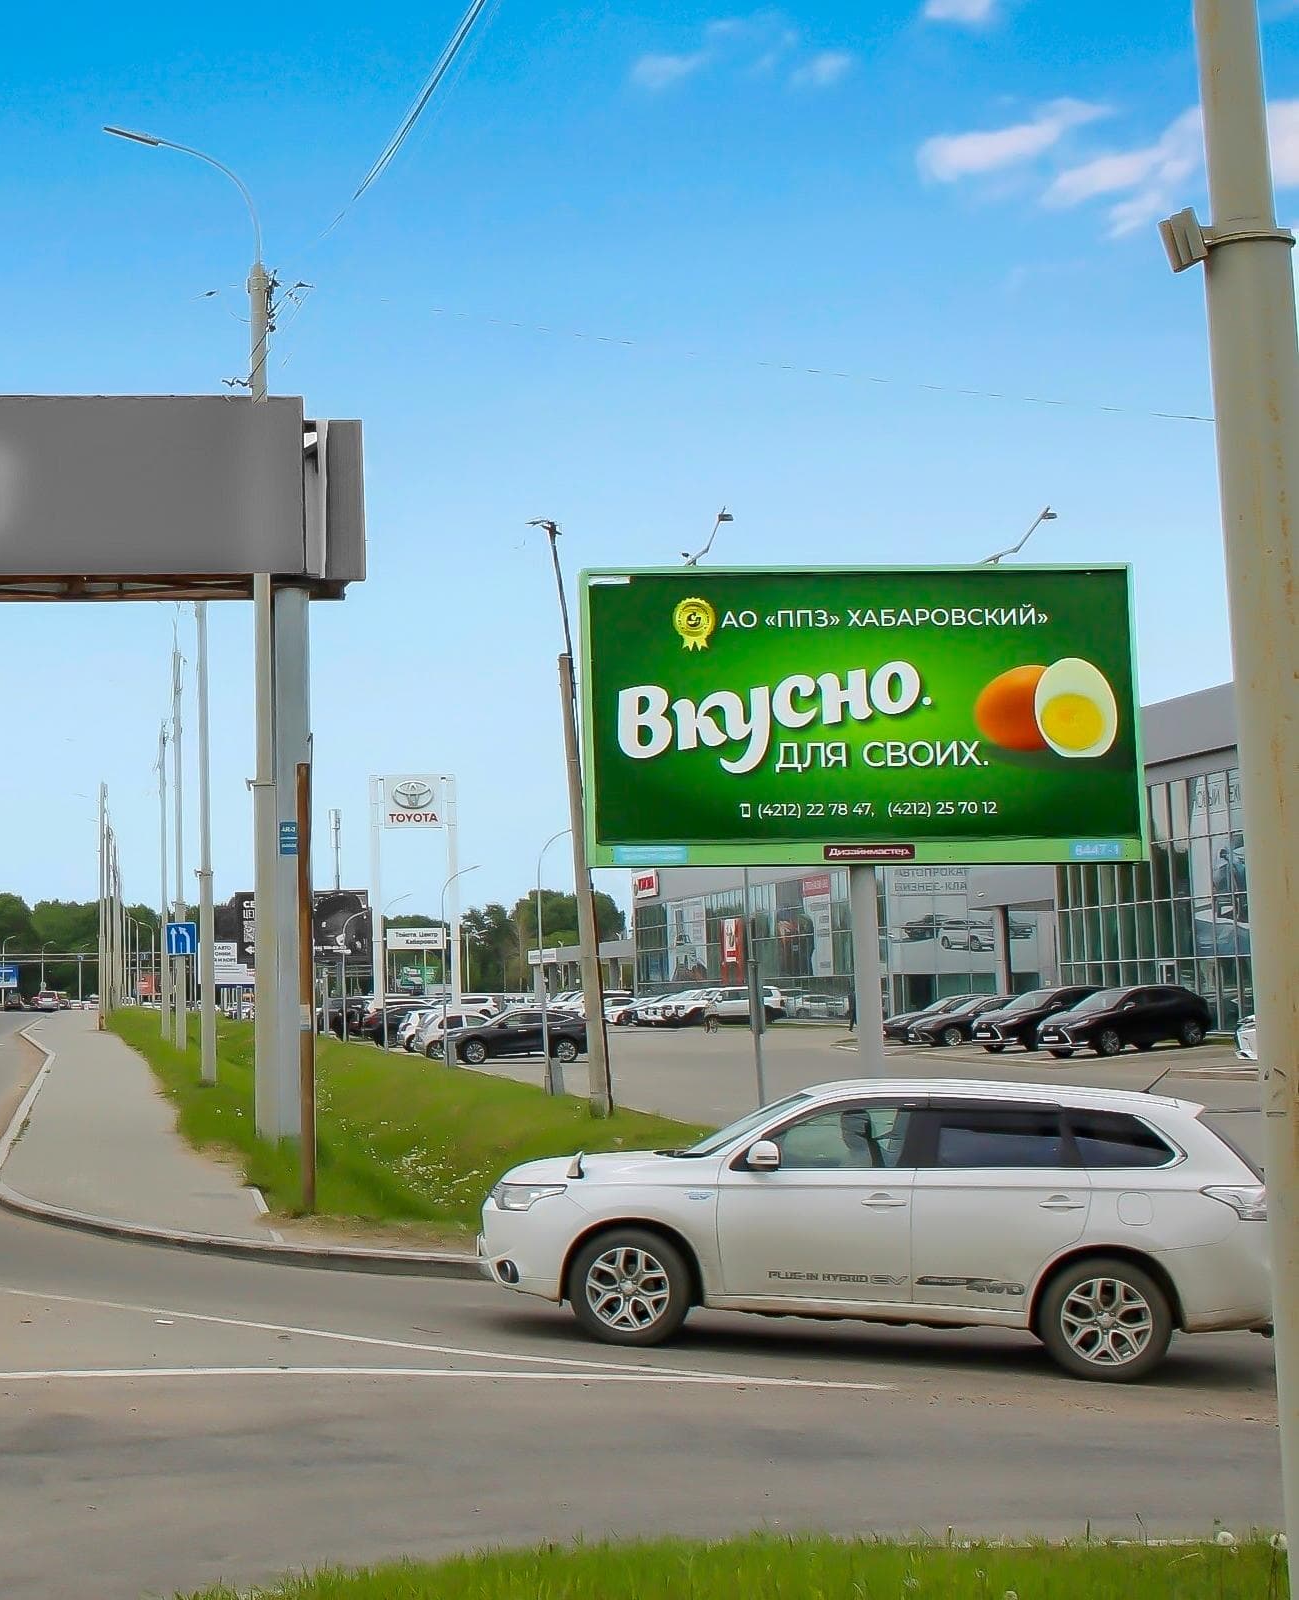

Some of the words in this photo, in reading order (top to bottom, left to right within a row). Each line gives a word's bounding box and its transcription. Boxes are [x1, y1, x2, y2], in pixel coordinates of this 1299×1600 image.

[721, 610, 758, 628] АО
[765, 609, 840, 628] «ППЗ»
[847, 603, 1048, 627] ХАБАРОВСКИЙ»
[617, 660, 933, 774] Вкусно.
[775, 742, 847, 772] ДЛЯ
[863, 740, 990, 768] СВОИХ.
[388, 813, 439, 823] TOYOTA
[757, 803, 802, 819] (4212)
[806, 803, 825, 817] 22
[828, 802, 848, 816] 78
[852, 802, 875, 818] 47,
[887, 802, 932, 818] (4212)
[936, 801, 955, 815] 25
[958, 801, 978, 815] 70
[982, 800, 998, 815] 12
[895, 882, 968, 892] БИЗНЕС-КЛА
[822, 1273, 869, 1283] HYBRID
